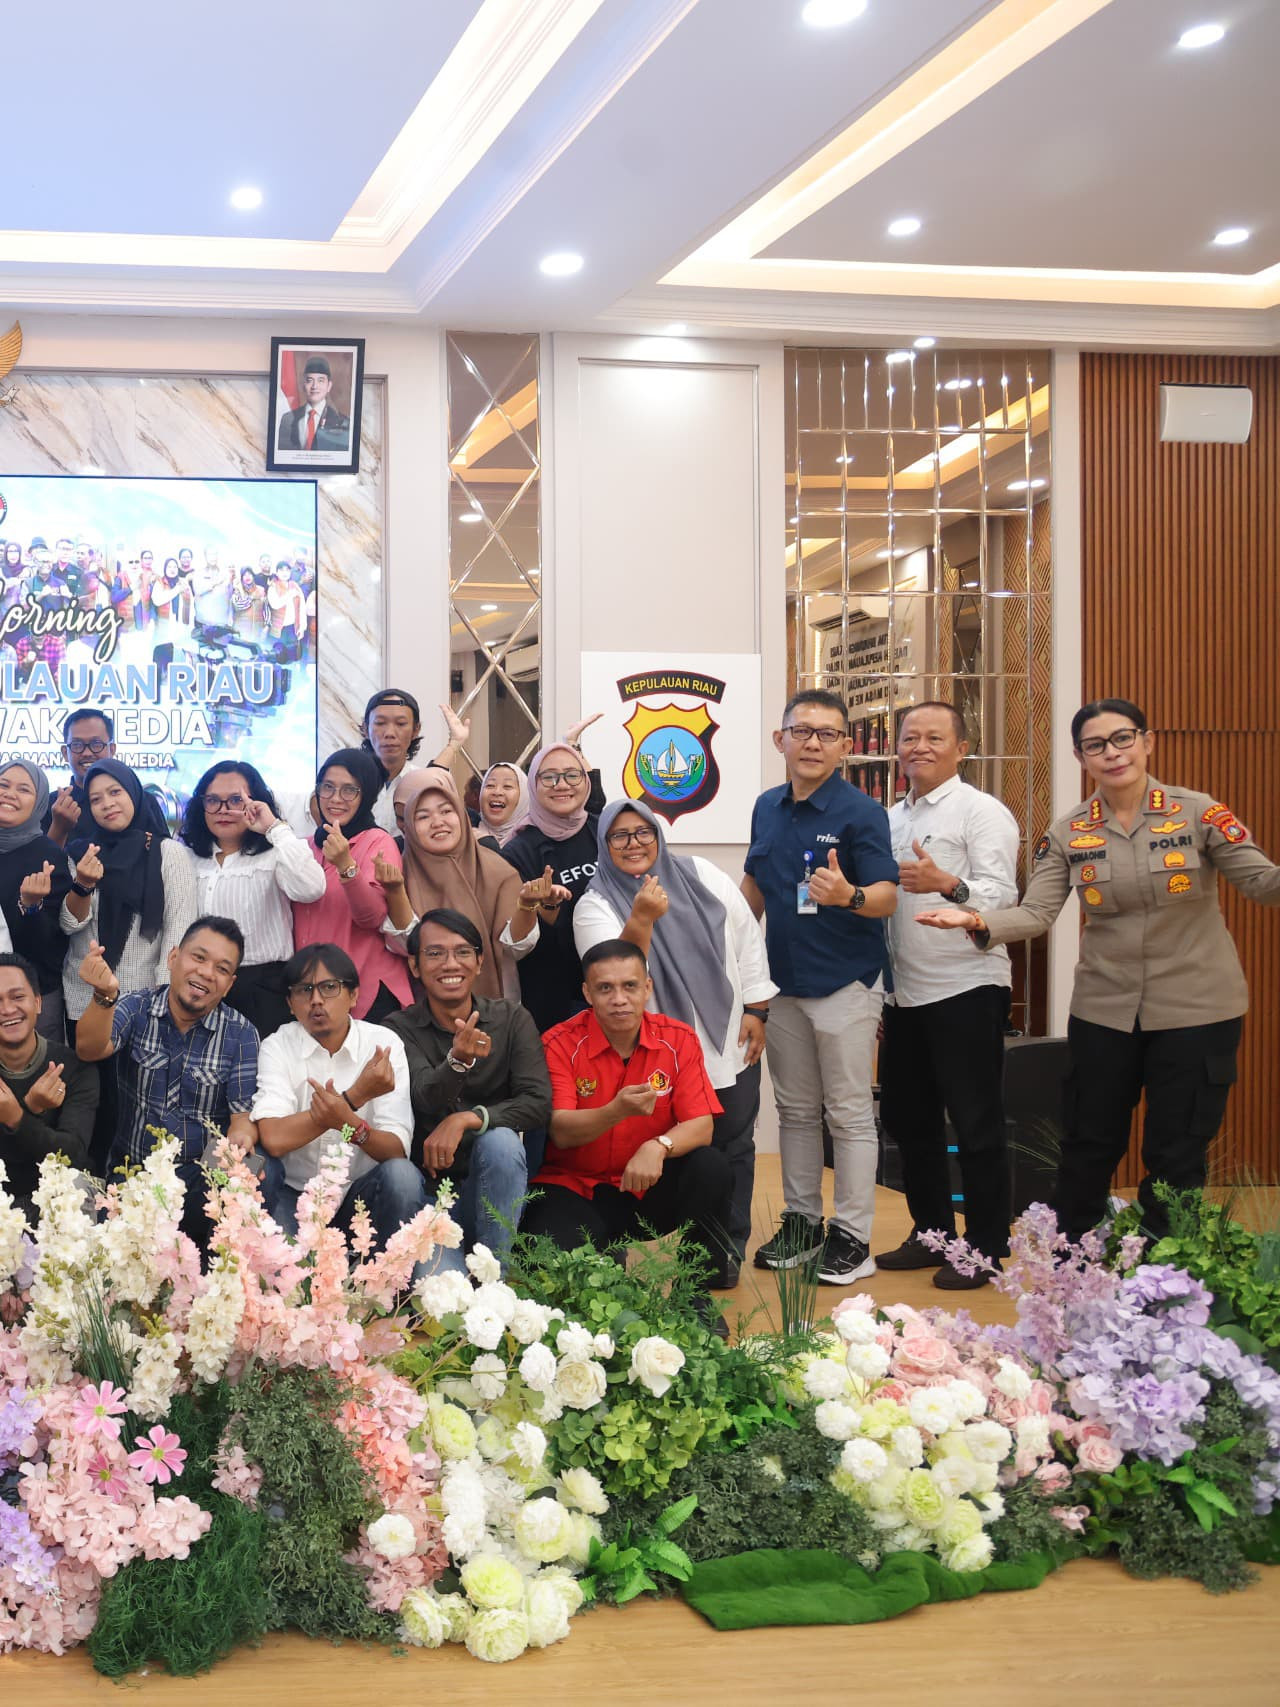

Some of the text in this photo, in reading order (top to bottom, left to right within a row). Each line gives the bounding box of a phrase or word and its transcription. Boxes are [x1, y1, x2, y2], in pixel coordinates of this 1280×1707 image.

[168, 662, 273, 703] RIAU
[624, 677, 718, 696] KEPULAUAN RIAU
[125, 753, 175, 768] MEDIA
[1149, 835, 1192, 851] POLRI
[560, 861, 599, 884] EFO
